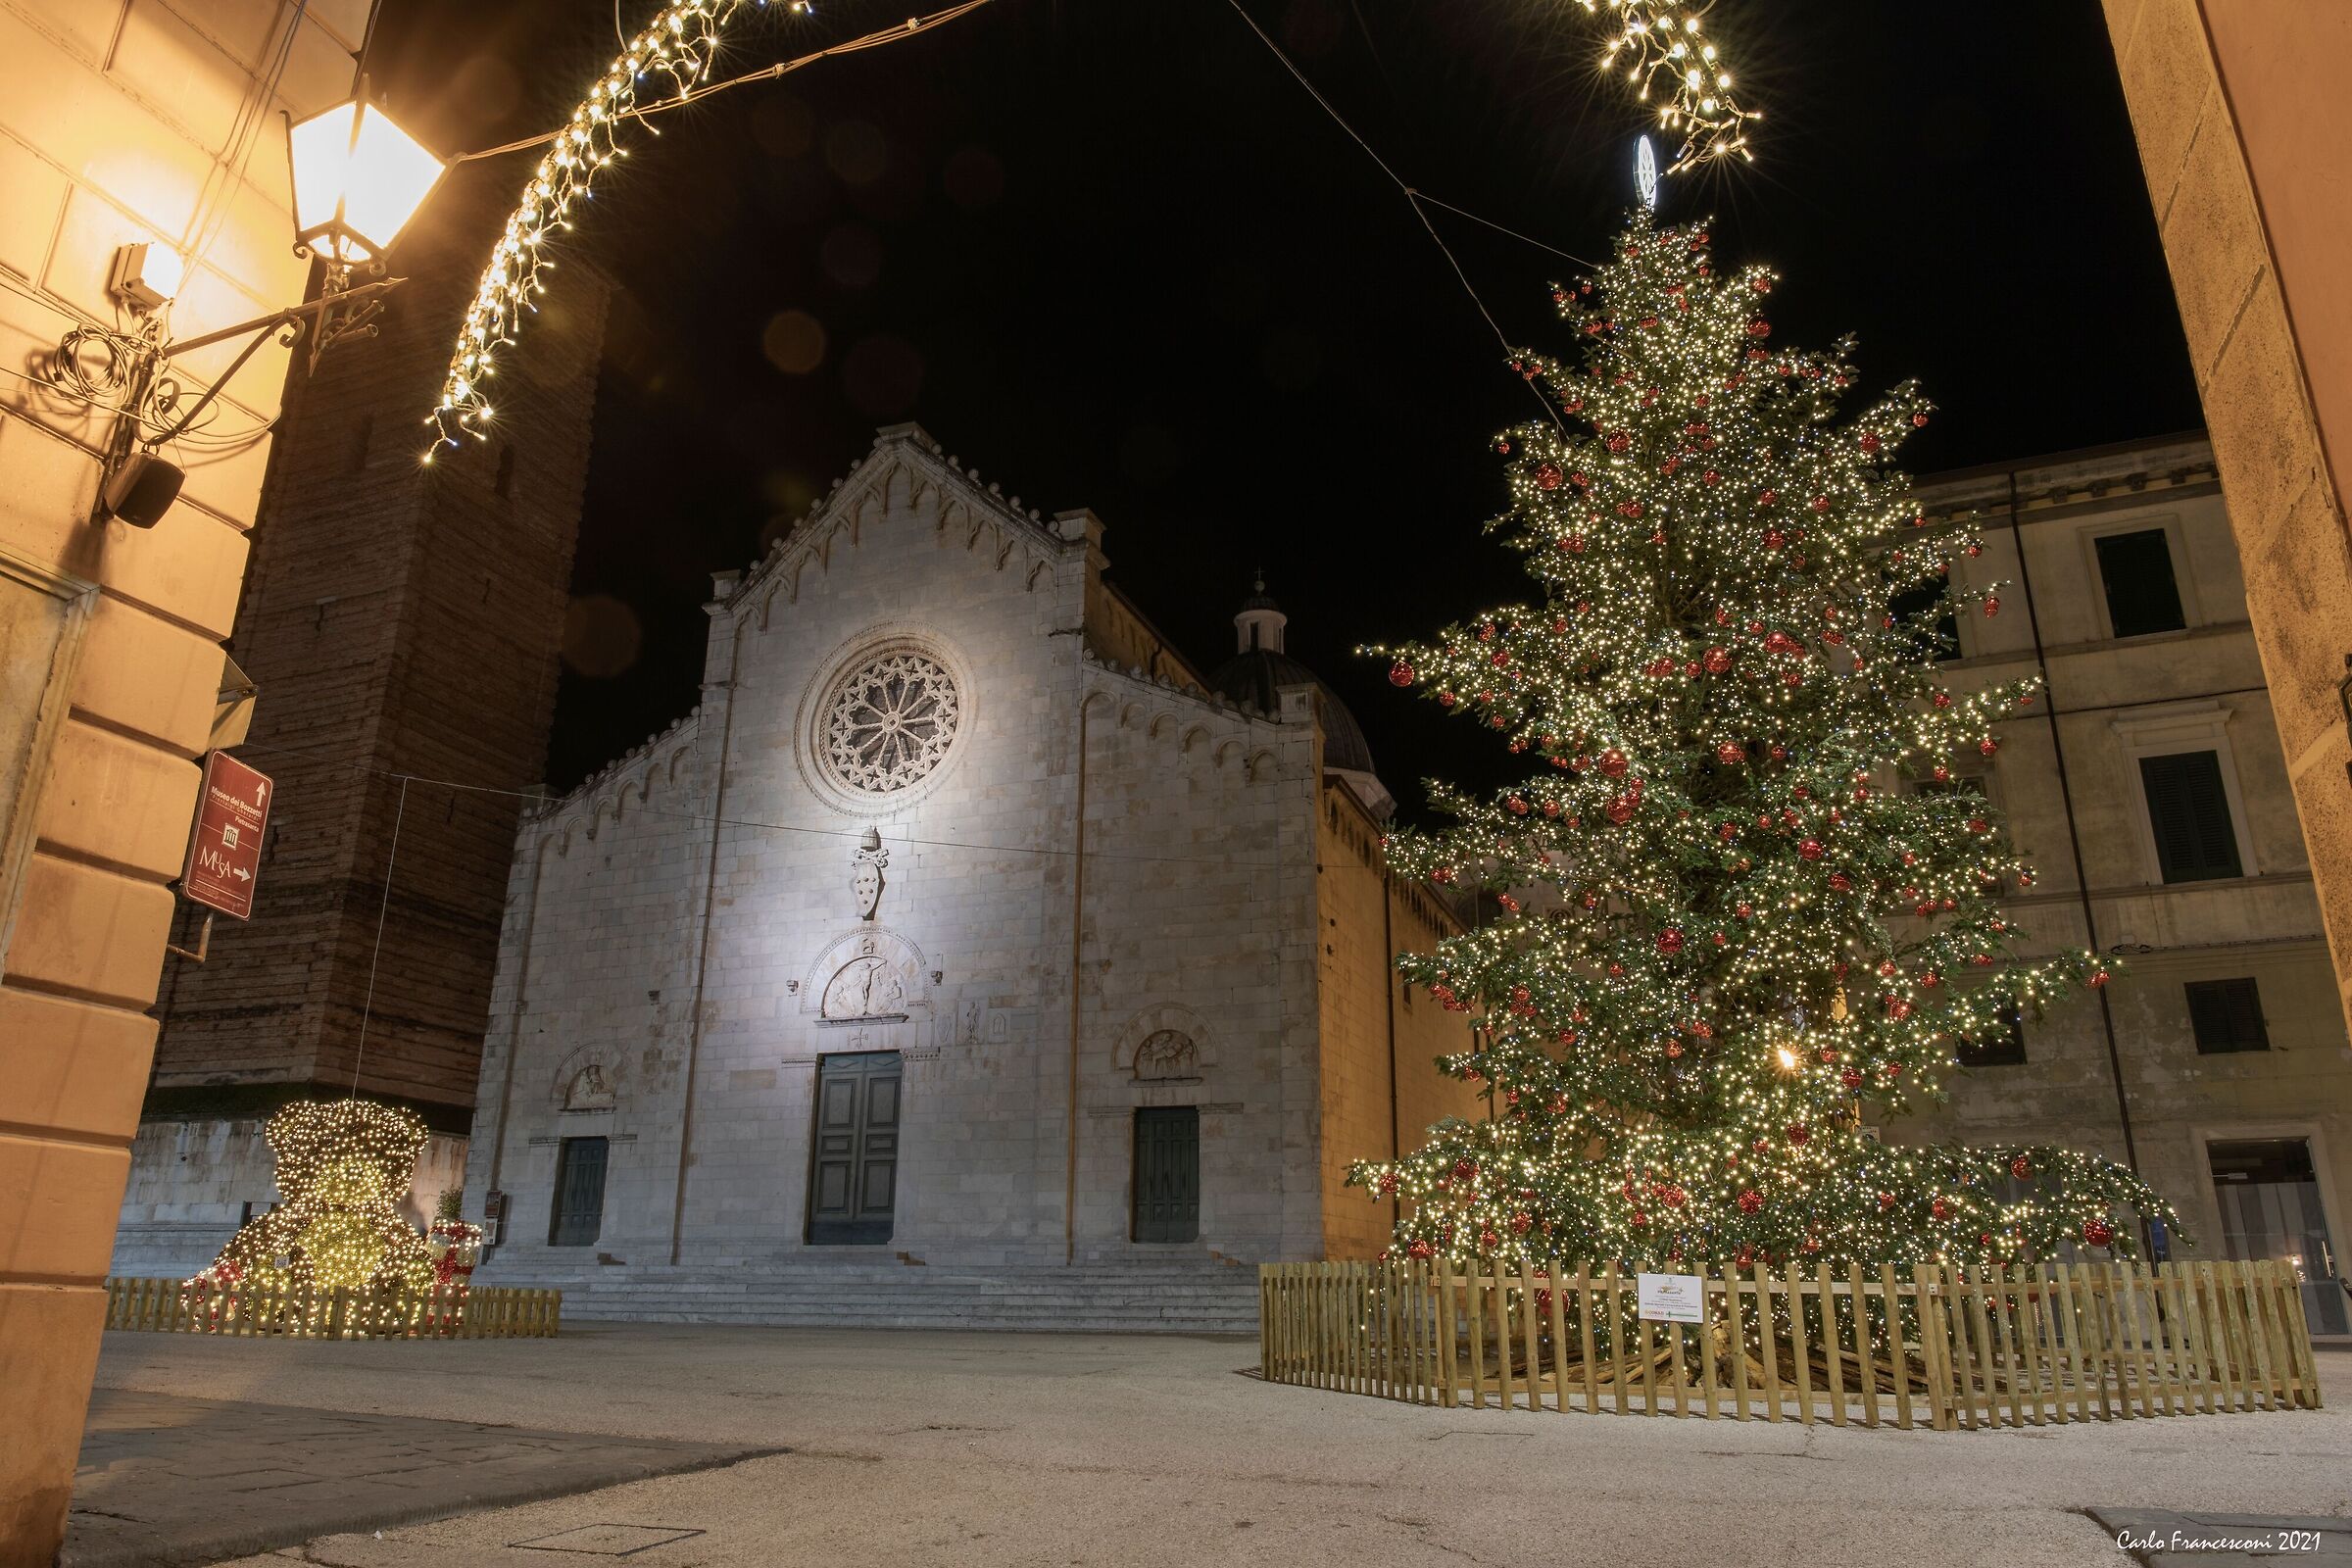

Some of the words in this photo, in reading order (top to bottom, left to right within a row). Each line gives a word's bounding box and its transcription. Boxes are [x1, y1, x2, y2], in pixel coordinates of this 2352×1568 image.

[211, 786, 230, 802] Museo
[230, 796, 240, 807] dei
[240, 801, 263, 818] Bozzetti
[235, 815, 260, 833] Pietrasanta
